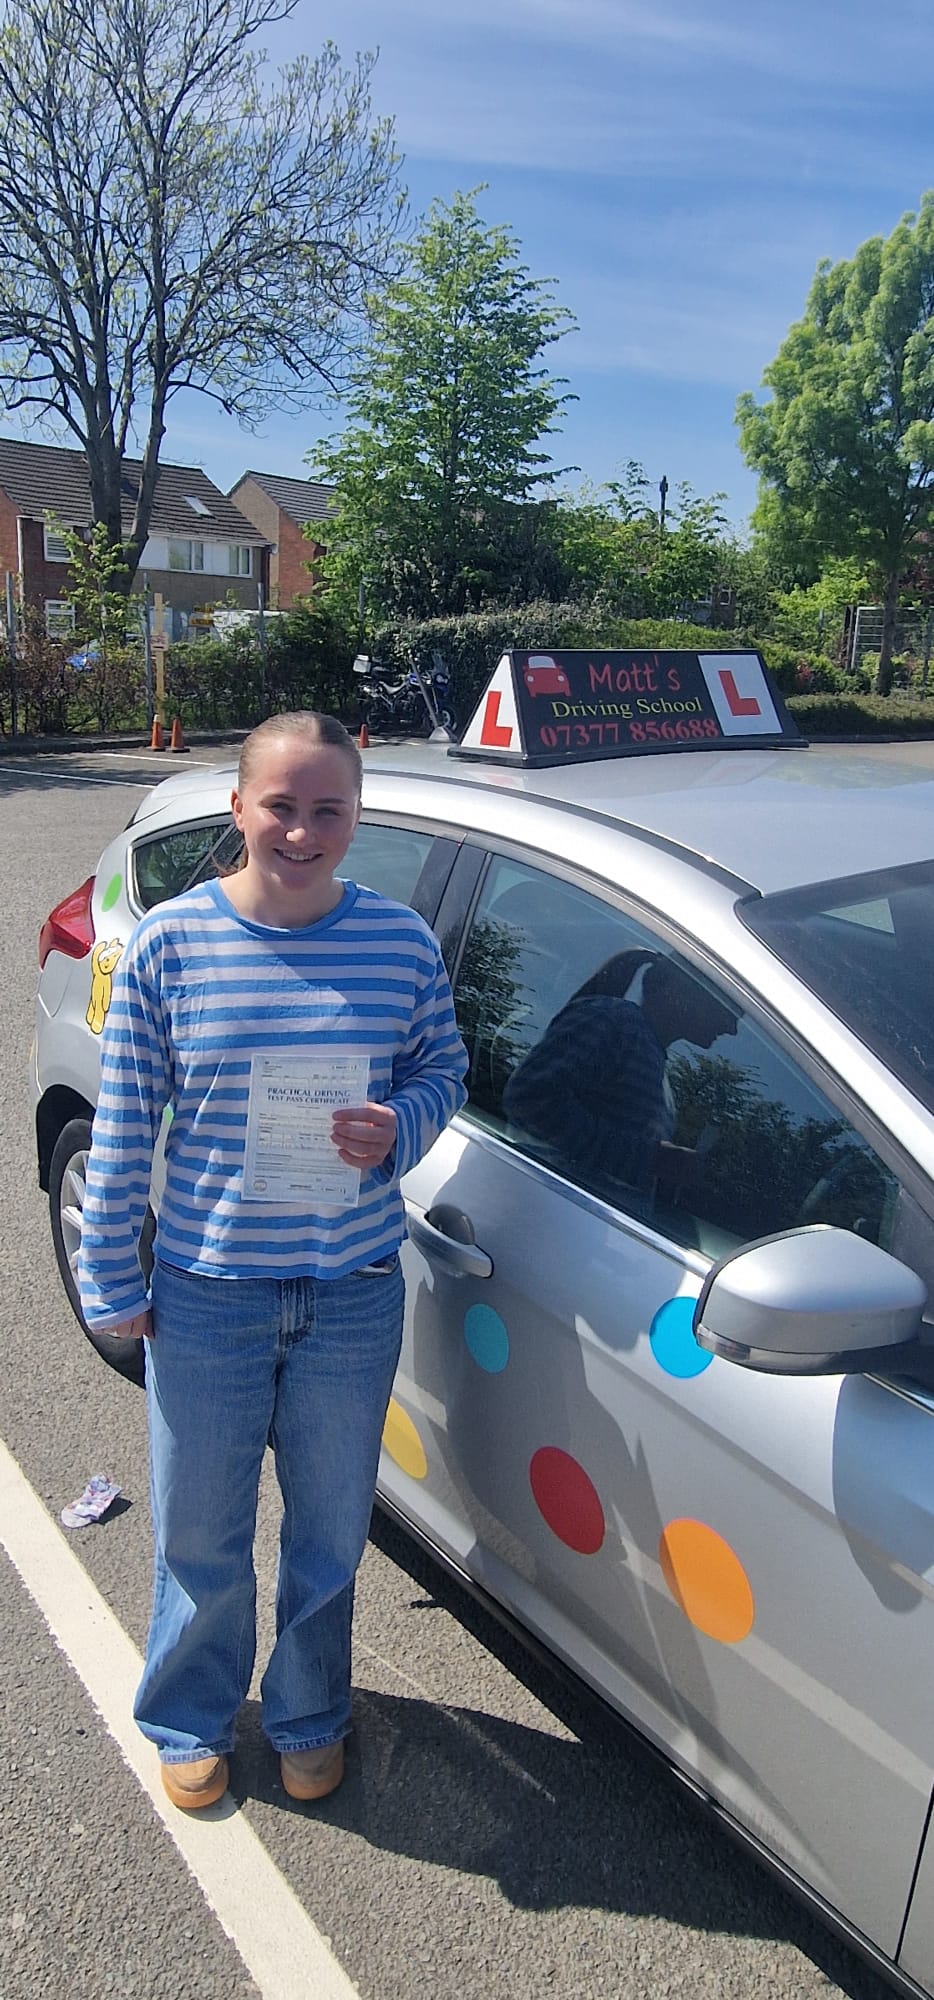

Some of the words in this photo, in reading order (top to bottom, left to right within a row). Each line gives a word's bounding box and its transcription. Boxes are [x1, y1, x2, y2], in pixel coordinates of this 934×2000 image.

[589, 656, 681, 693] Matt's
[551, 700, 633, 720] Driving
[638, 697, 704, 714] School
[718, 670, 761, 716] L
[480, 691, 512, 747] L
[540, 722, 621, 748] 07377
[631, 718, 719, 742] 856688
[267, 1087, 312, 1097] PRACTICAL
[314, 1089, 351, 1097] DRIVING
